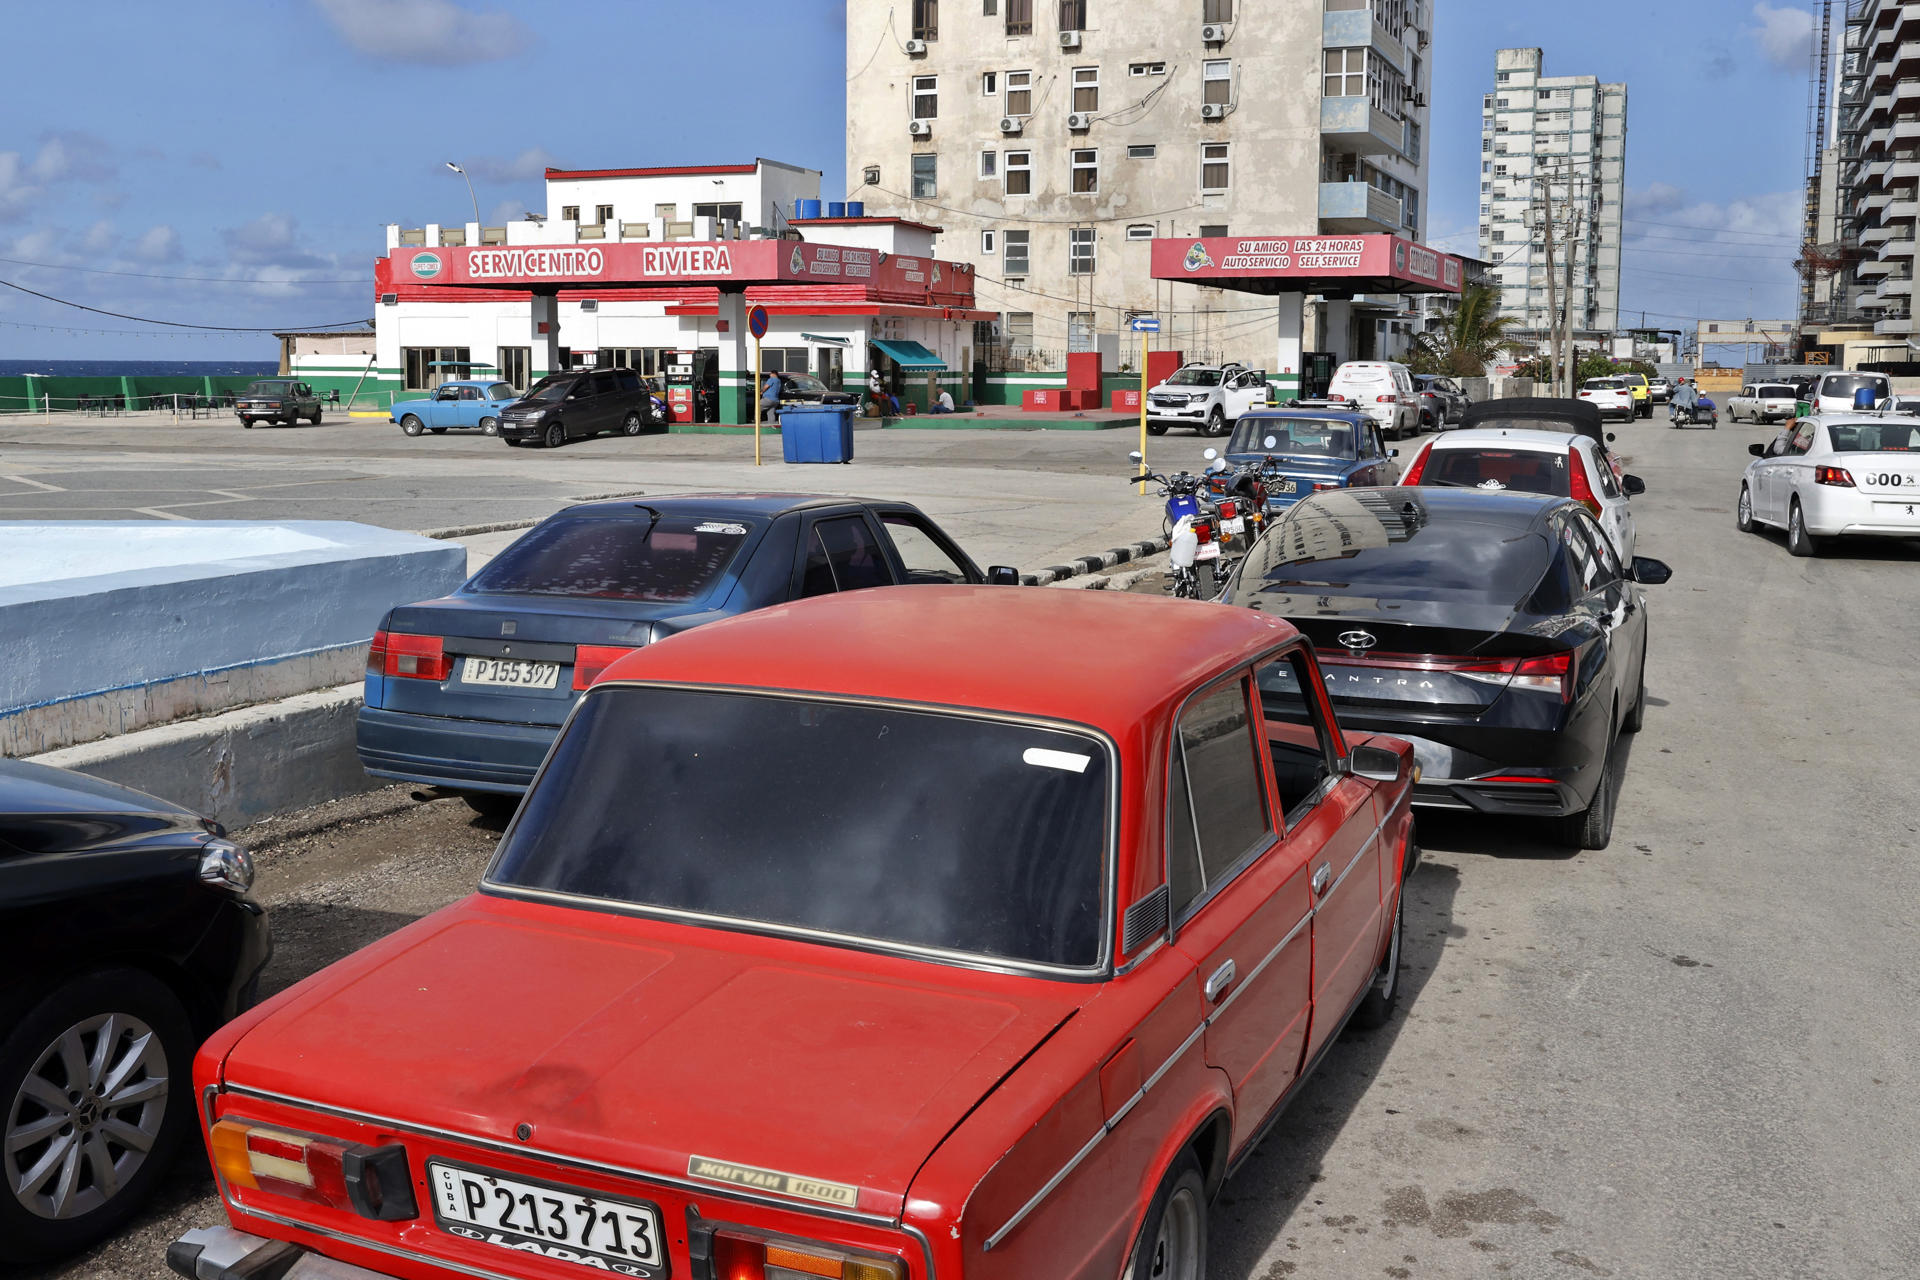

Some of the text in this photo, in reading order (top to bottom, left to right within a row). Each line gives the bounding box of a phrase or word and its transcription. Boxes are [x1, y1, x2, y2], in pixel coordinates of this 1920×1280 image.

[1238, 240, 1363, 253] SU AMIGO LAS 24 HORAS
[469, 247, 731, 276] SERVICENTRO RIVIERA
[1300, 256, 1320, 267] SELF
[1321, 255, 1359, 267] SERVICE
[1865, 472, 1902, 487] 600
[1278, 670, 1433, 689] EANTRA
[442, 1171, 457, 1213] CUBA
[795, 1181, 848, 1202] 1600
[486, 1233, 610, 1271] LADA
